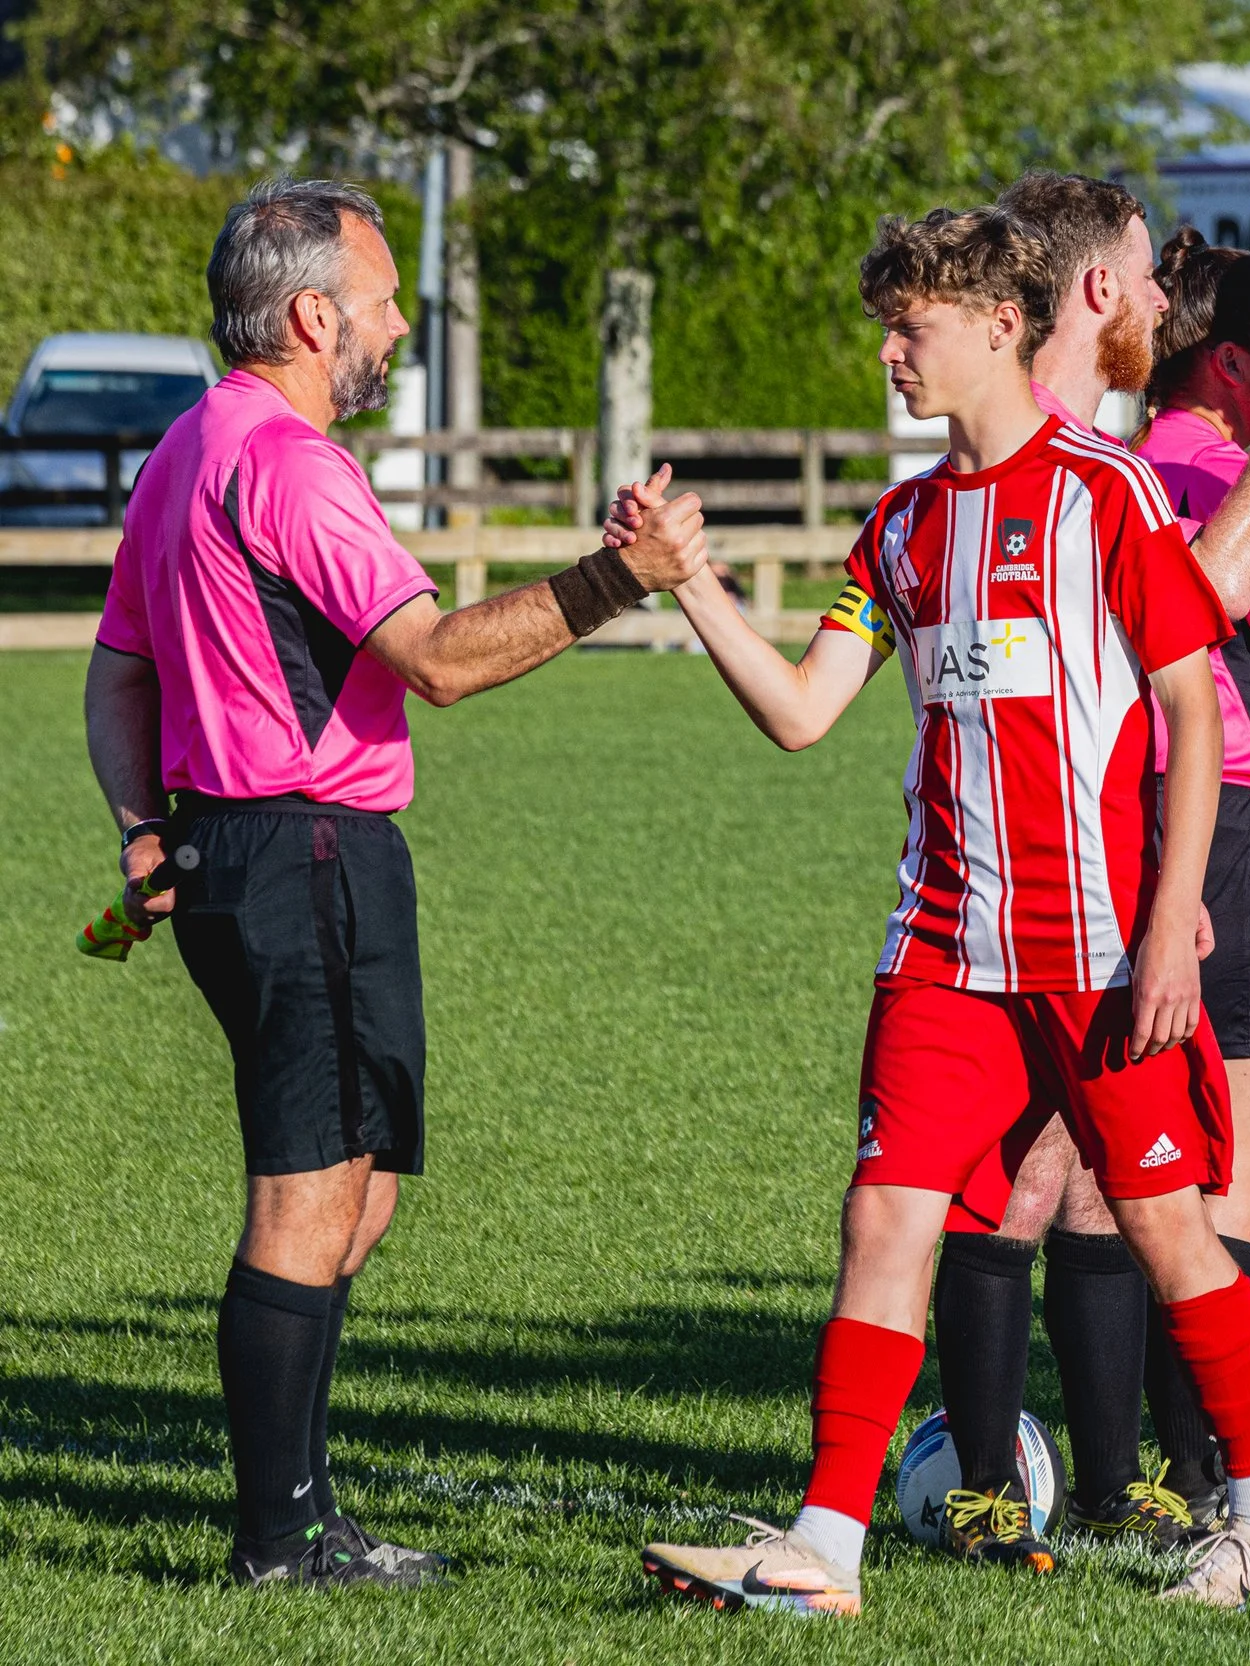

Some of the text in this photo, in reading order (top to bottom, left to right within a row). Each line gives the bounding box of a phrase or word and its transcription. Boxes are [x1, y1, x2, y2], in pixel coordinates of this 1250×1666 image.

[996, 564, 1035, 572] CAMBRIDGE
[991, 571, 1041, 582] FOOTBALL
[956, 690, 980, 698] Advisory
[983, 687, 1014, 695] Services
[1139, 1148, 1182, 1168] adidas
